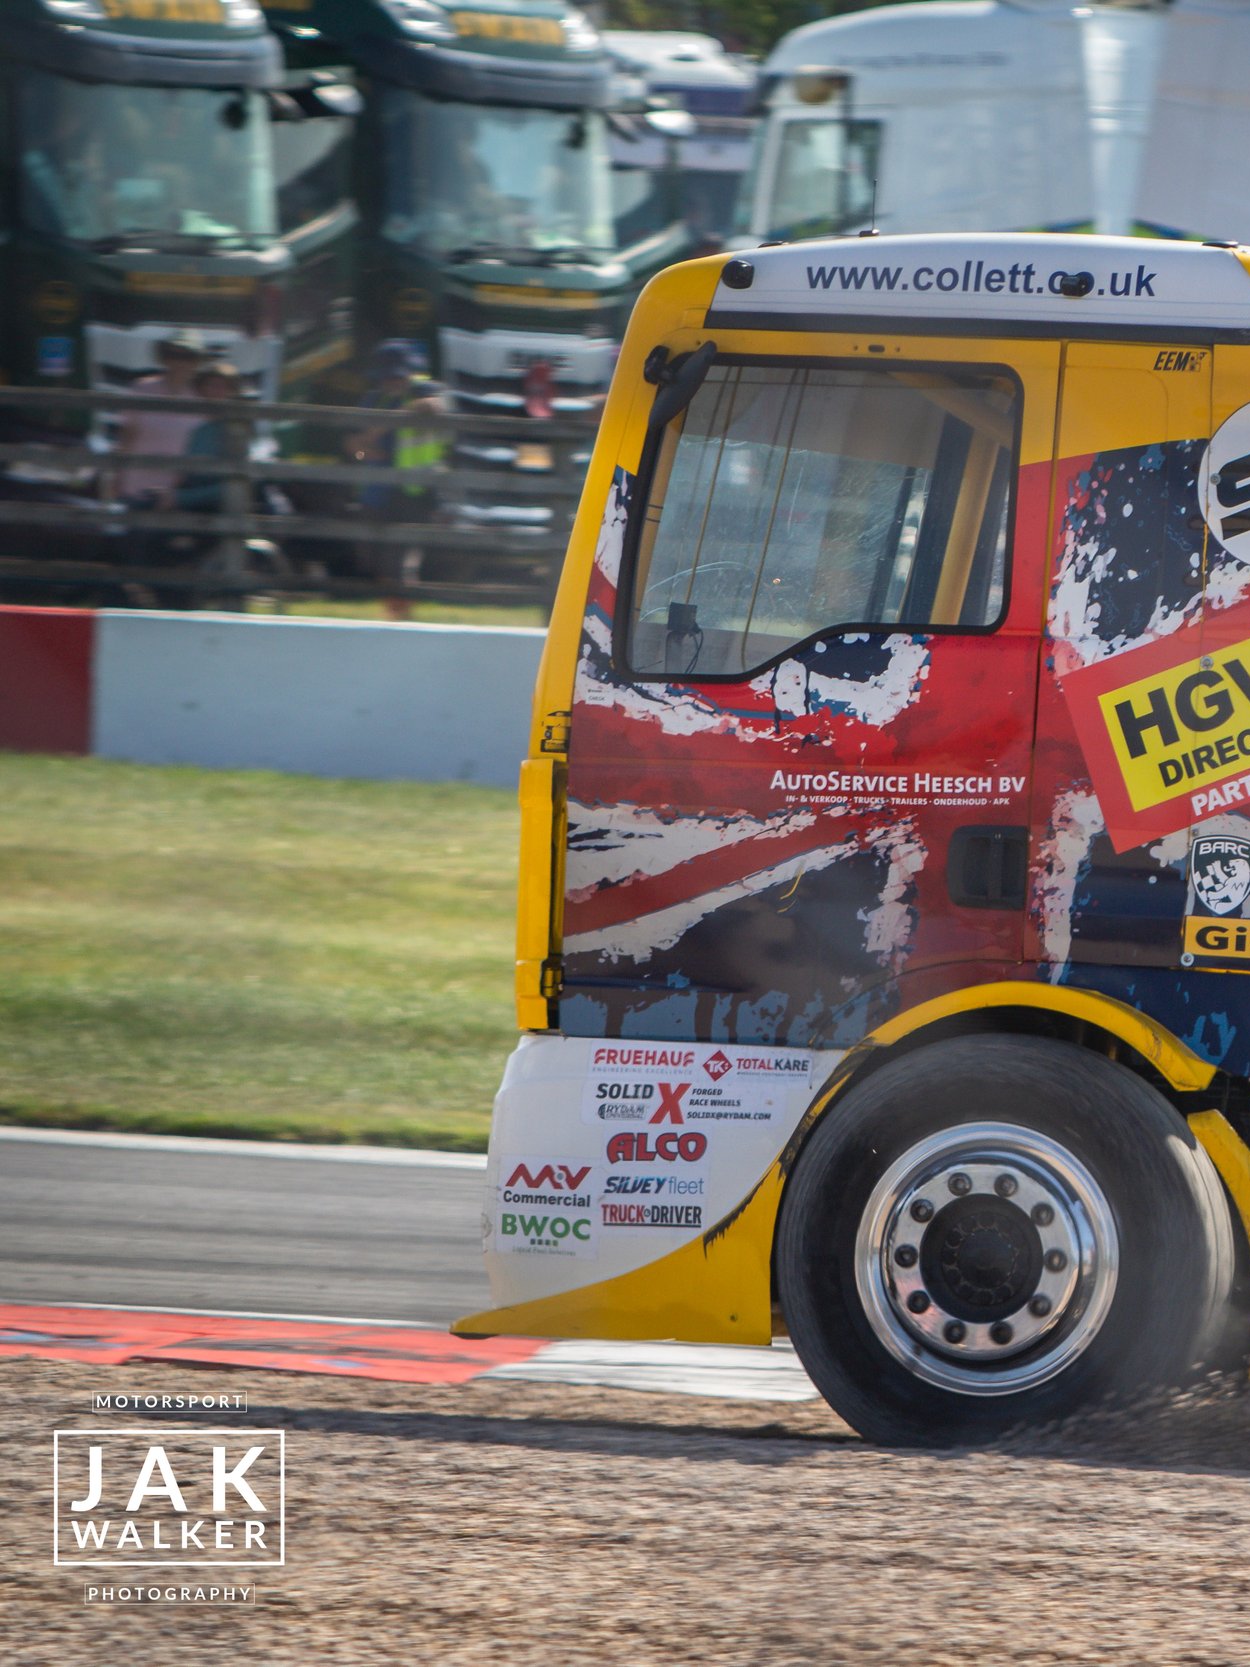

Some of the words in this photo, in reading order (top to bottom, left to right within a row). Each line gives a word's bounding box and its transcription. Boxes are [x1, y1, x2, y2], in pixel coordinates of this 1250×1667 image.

[998, 775, 1026, 793] BV
[809, 795, 848, 804] VERKOOP
[853, 796, 886, 805] TRUCKS
[890, 797, 928, 806] TRAILERS
[933, 797, 988, 807] ONDERHOUD
[992, 797, 1010, 806] APK
[1199, 841, 1250, 858] BARC
[593, 1048, 695, 1067] FRUEHAUF
[736, 1058, 809, 1072] TOTALKARE
[692, 1088, 723, 1096] FORGED
[596, 1083, 654, 1100] SOLID
[649, 1082, 692, 1125] X
[689, 1099, 709, 1107] RACE
[709, 1099, 741, 1107] WHEELS
[687, 1111, 771, 1121] SOLIDX@RYDAM.COM
[668, 1177, 705, 1195] fleet
[503, 1190, 591, 1208] Commercial
[601, 1204, 644, 1222] TRUCK
[651, 1205, 702, 1224] DRIVER
[501, 1213, 591, 1241] BWOC
